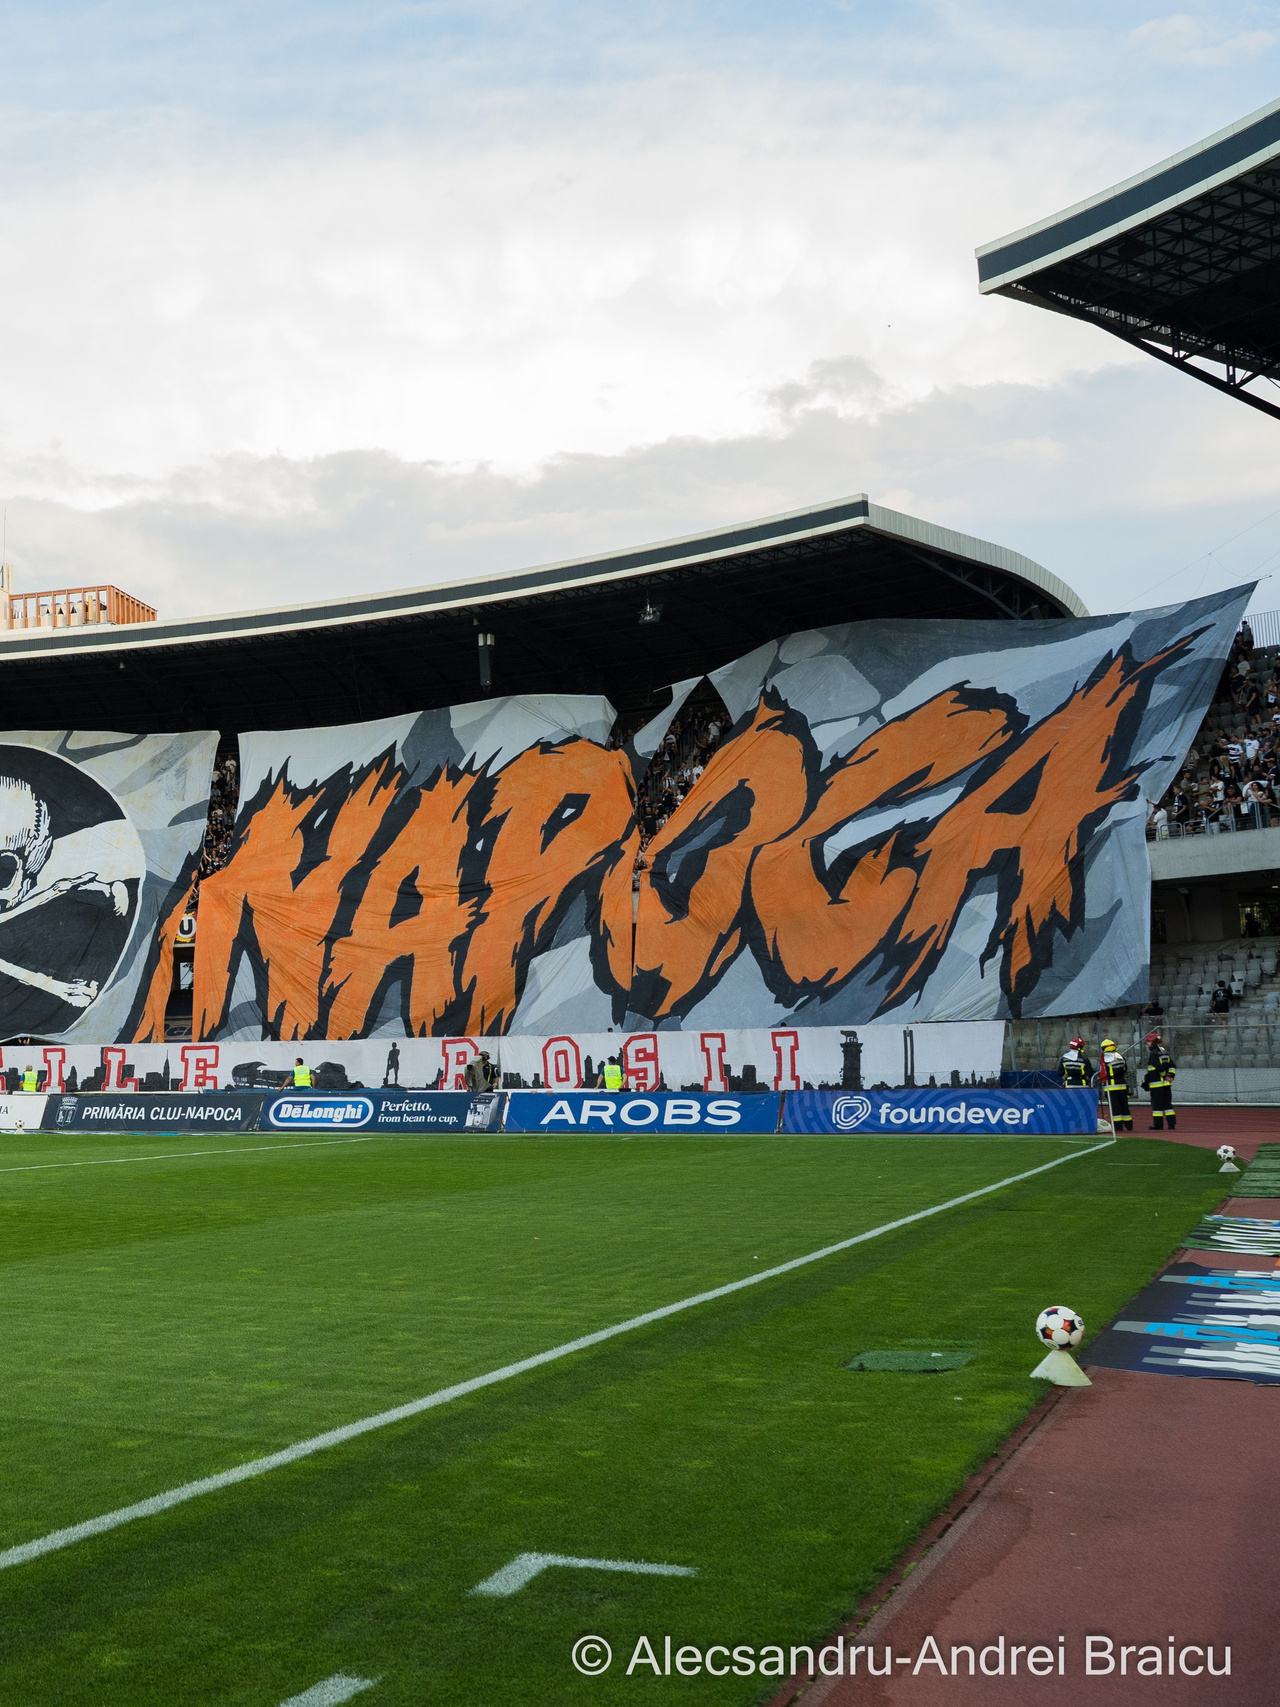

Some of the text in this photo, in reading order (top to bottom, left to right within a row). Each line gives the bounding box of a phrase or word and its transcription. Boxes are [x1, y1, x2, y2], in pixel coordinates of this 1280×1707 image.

[132, 624, 1212, 1042] NAPOCA
[81, 1103, 242, 1121] PRIMĂRIA CLUJ-NAPOCA
[380, 1100, 432, 1112] Perfetto,
[540, 1100, 741, 1126] AROBS
[879, 1102, 1034, 1126] foundever
[377, 1113, 459, 1126] from bean to cup.
